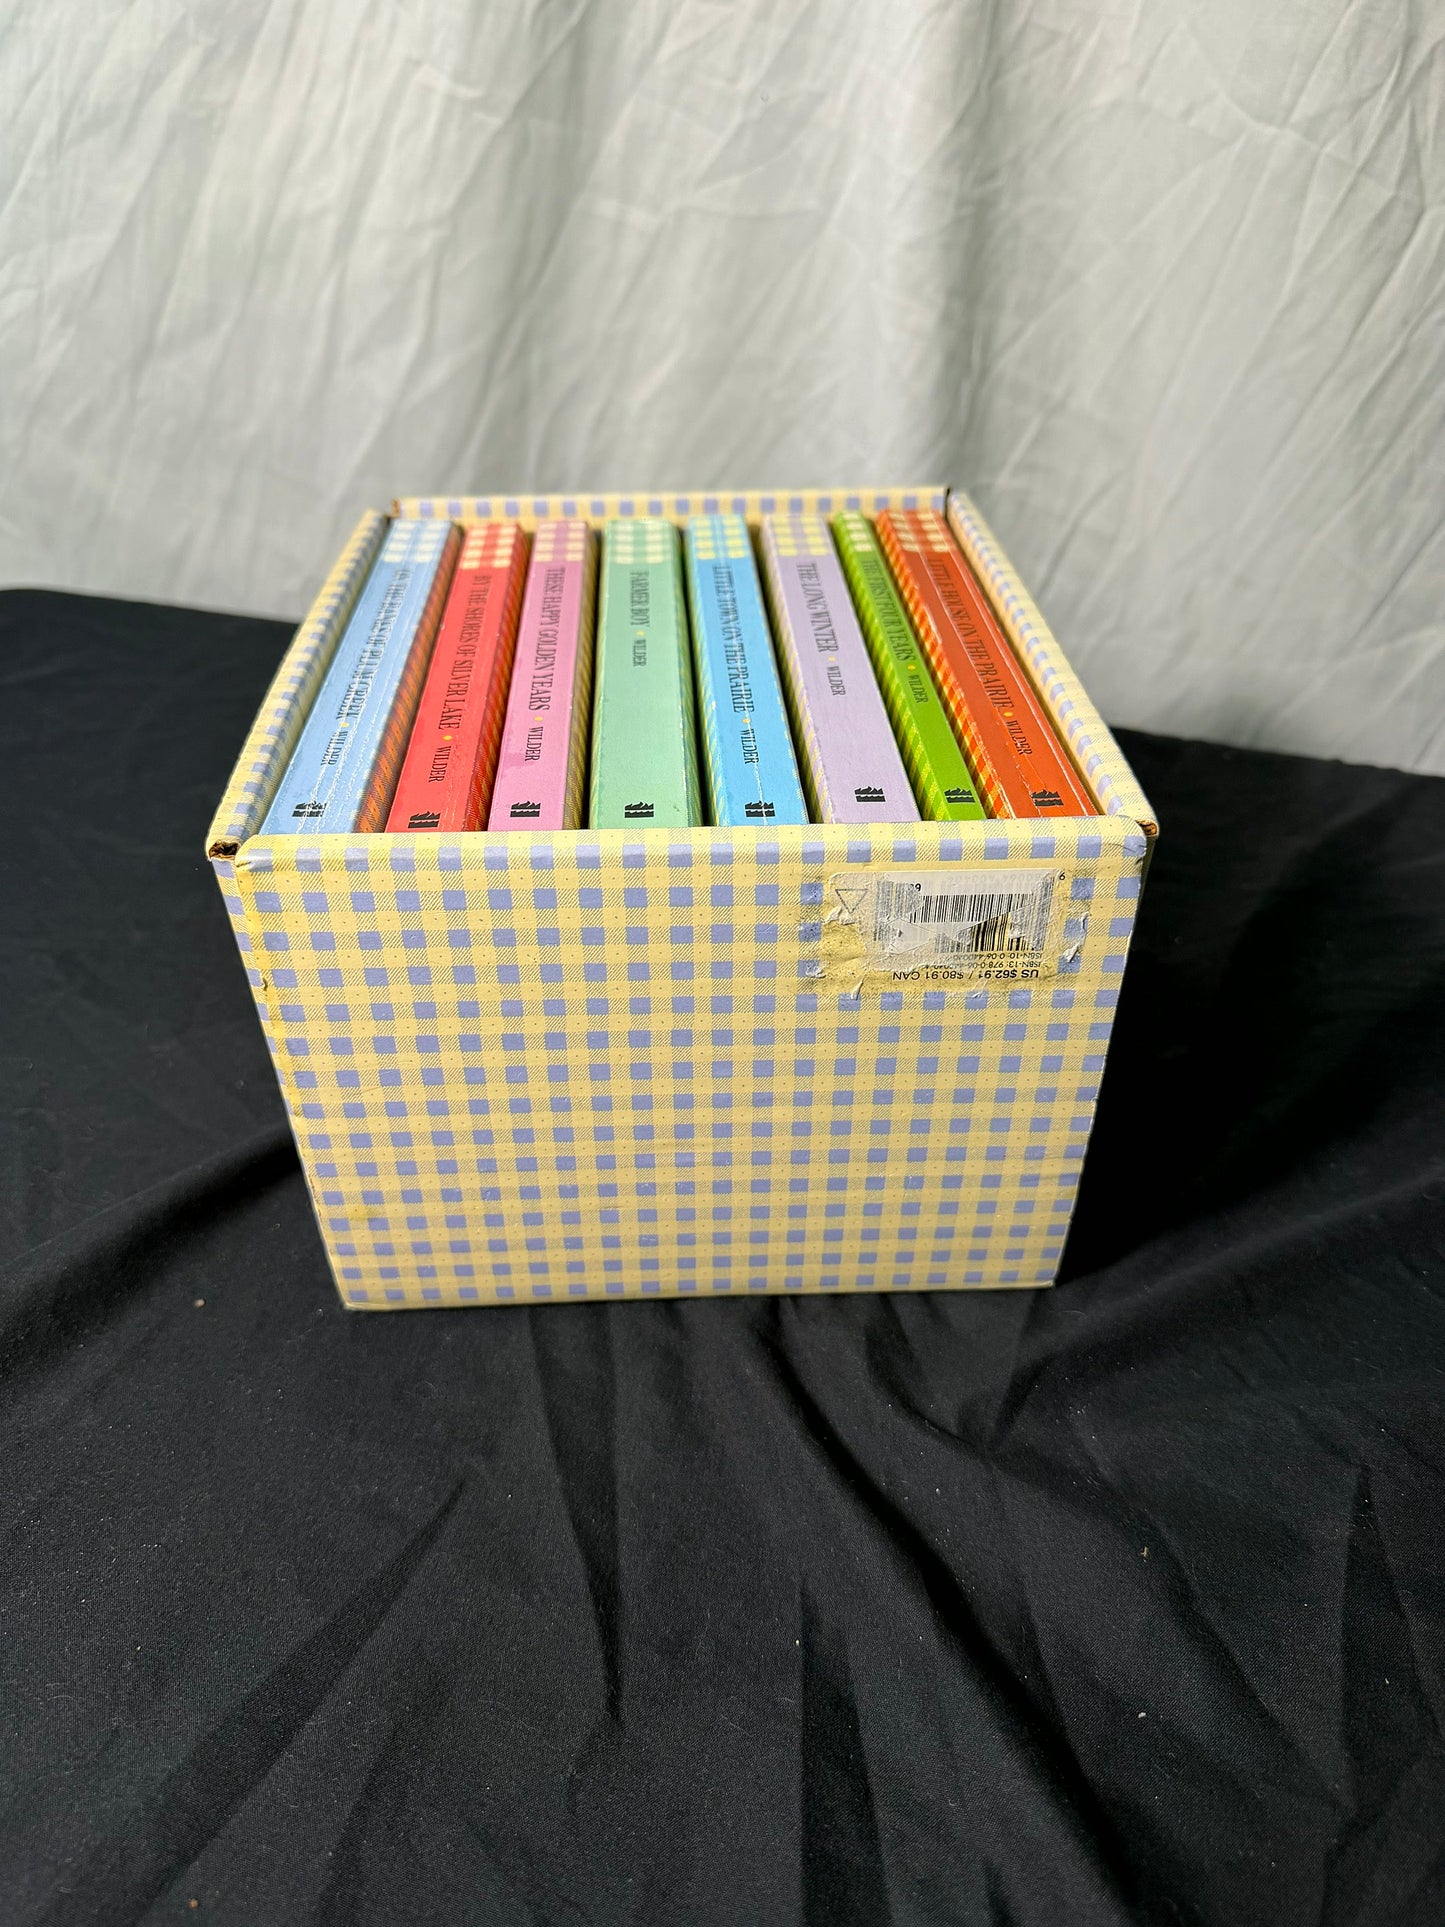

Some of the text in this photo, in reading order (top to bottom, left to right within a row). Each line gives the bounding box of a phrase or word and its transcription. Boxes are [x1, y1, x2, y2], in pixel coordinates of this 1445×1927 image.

[468, 587, 489, 606] THE
[941, 590, 972, 621] HOUSE
[459, 607, 485, 643] SHORES
[630, 571, 650, 667] FARMER BOY WILDER
[796, 562, 847, 696] THE LONG WINTER WILDER
[862, 559, 929, 704] THE FIRST FOUR YEARS WILDER
[957, 622, 980, 638] ON
[456, 645, 477, 657] OF
[525, 567, 566, 761] THESE HAPPY GOLDEN YEARS WILDER
[713, 565, 760, 764] LITTLE TOWN ON THE PRAIRIE WILDER
[965, 639, 991, 662] THE
[447, 660, 474, 697] SILVER
[974, 662, 1015, 712] PRAIRIE
[336, 681, 370, 720] CREEK
[438, 699, 466, 730] LAKE
[321, 731, 348, 766] WILDER
[1005, 720, 1034, 756] WILDER
[428, 746, 452, 782] WILDER
[892, 971, 921, 981] CAN
[925, 970, 964, 981] $80.91
[978, 969, 1018, 980] $62.91
[1020, 969, 1040, 979] US
